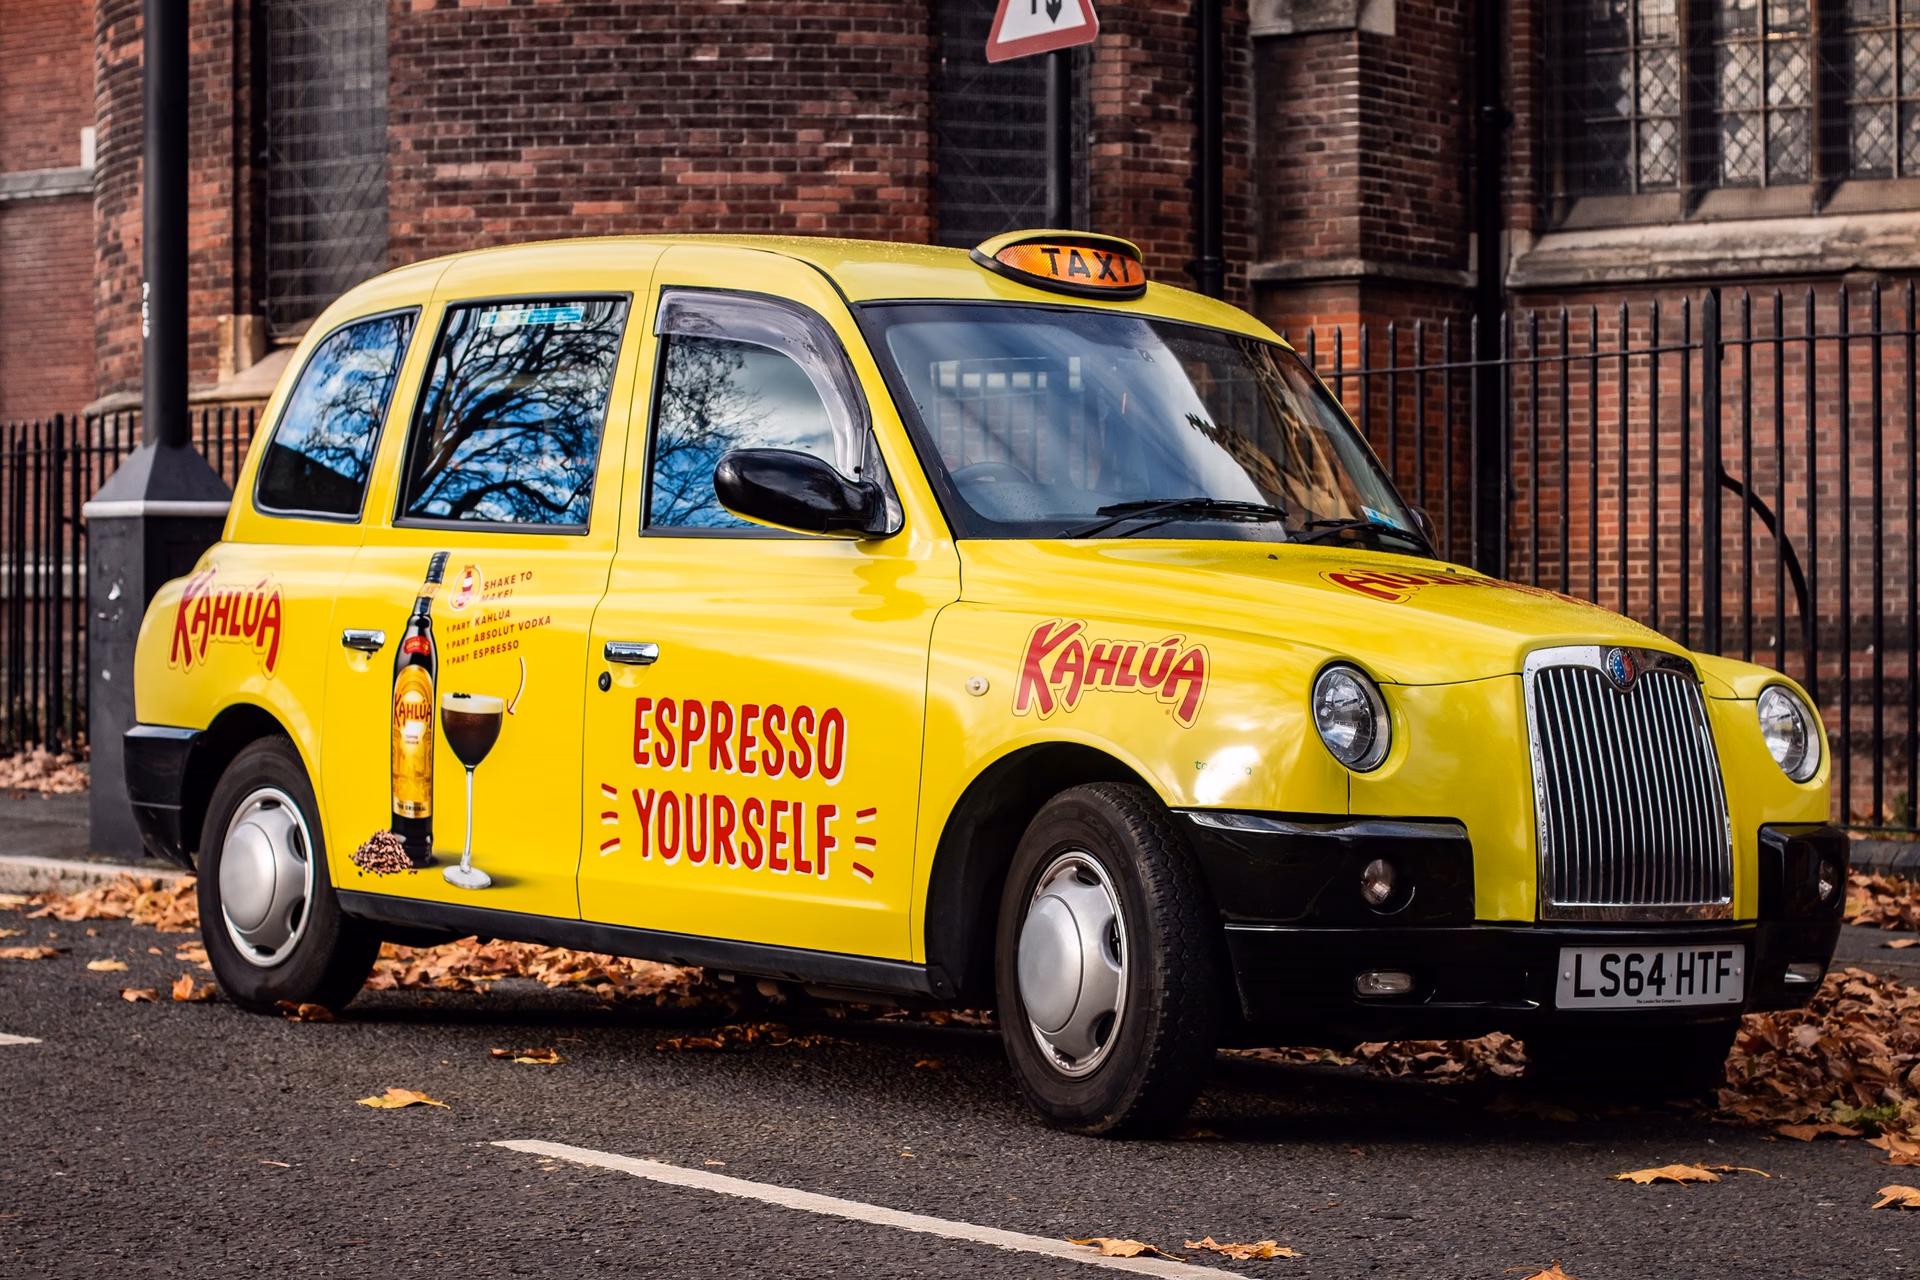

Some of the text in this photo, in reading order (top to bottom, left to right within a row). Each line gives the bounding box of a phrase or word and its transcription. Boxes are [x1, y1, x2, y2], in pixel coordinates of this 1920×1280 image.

[1040, 247, 1130, 283] TAXI
[480, 589, 513, 602] MAKE!
[484, 571, 533, 591] SHAKE TO
[170, 567, 282, 673] KAHLÚA
[452, 621, 471, 632] PART
[452, 637, 470, 649] PART
[473, 624, 515, 643] ABSOLUT
[518, 615, 551, 631] VODKA
[452, 653, 470, 665] PART
[473, 639, 520, 660] ESPRESSO
[1016, 621, 1205, 723] KAHLÚA
[394, 693, 432, 729] KAHLÚA
[633, 697, 847, 785] ESPRESSO
[632, 788, 840, 880] YOURSELF
[1573, 950, 1734, 998] LS64 HTF
